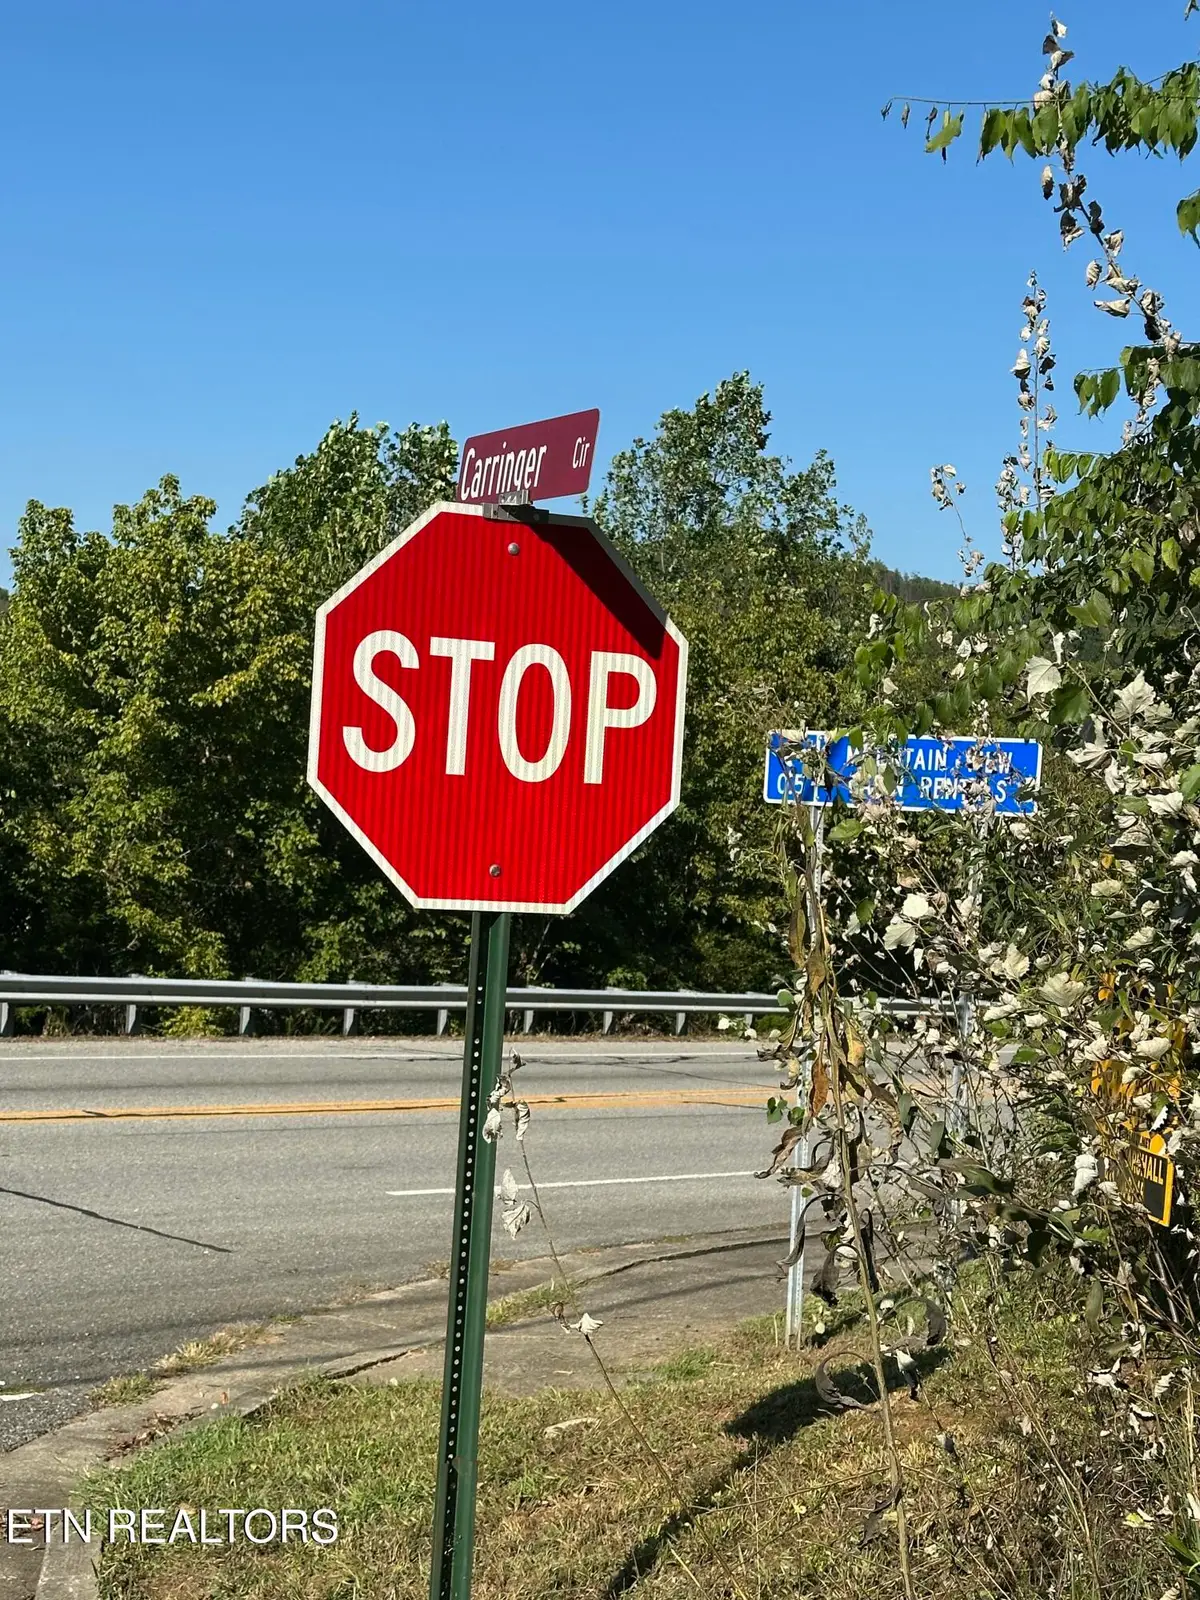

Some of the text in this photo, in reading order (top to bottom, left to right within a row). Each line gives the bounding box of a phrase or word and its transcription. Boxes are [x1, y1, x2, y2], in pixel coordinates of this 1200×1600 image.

[460, 436, 591, 501] Carringer Cir
[342, 629, 657, 784] STOP
